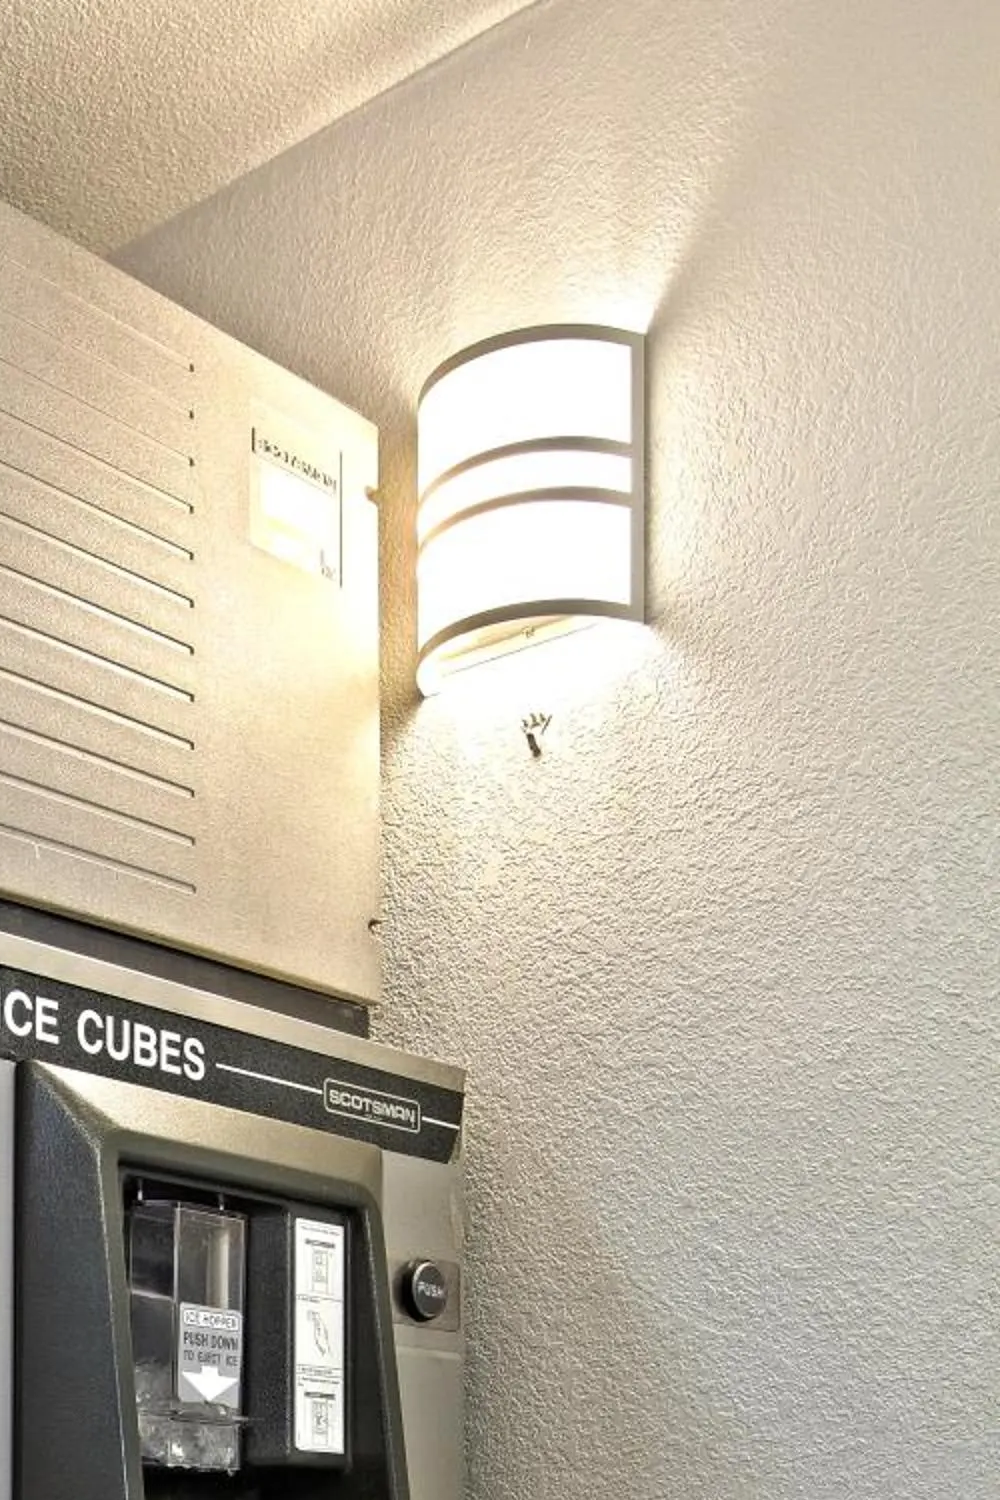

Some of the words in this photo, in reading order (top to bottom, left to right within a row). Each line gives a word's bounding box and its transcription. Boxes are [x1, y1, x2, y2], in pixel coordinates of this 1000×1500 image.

[76, 1008, 206, 1081] CUBES
[329, 1089, 416, 1123] SCOTSMAN
[417, 1281, 444, 1298] PUSH
[183, 1331, 209, 1347] PUSH
[210, 1334, 238, 1351] DOWN
[183, 1349, 194, 1361] TO
[226, 1354, 238, 1367] ICE
